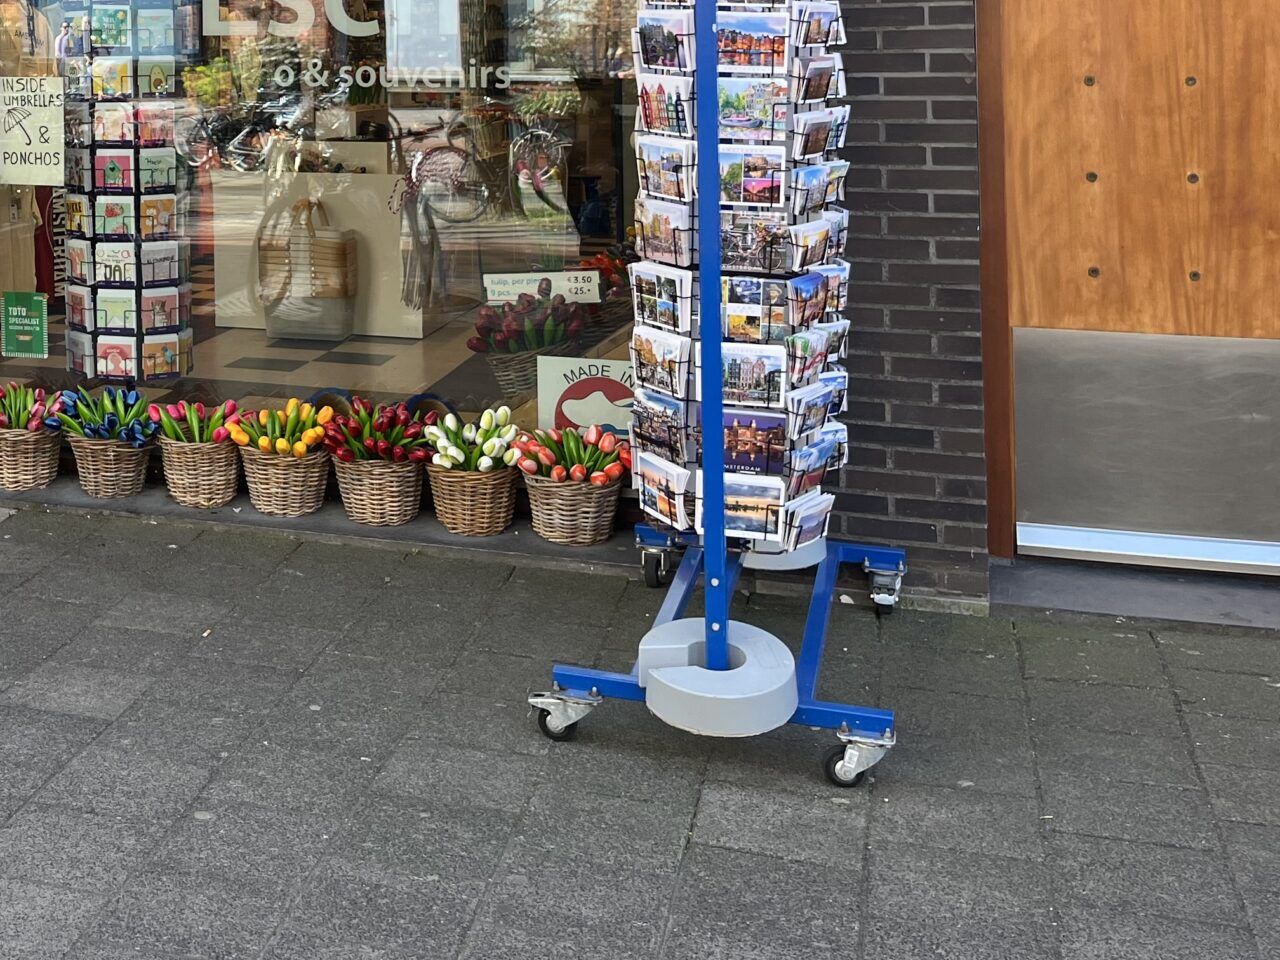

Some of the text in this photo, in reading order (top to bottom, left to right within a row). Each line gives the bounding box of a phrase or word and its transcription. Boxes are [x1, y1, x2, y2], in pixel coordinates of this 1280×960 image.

[303, 59, 330, 88] &
[342, 58, 511, 89] souvenirs
[2, 78, 47, 93] INSIDE
[3, 94, 64, 107] UMBRELLAS
[39, 126, 51, 144] &
[3, 152, 61, 166] PONCHOS
[53, 188, 66, 297] AMSTERDAM
[721, 264, 764, 272] AMSTERDAM
[8, 306, 27, 316] TOTO
[8, 317, 40, 325] SPECIALIST
[562, 364, 612, 384] MADE
[723, 464, 761, 472] MSTERDAM
